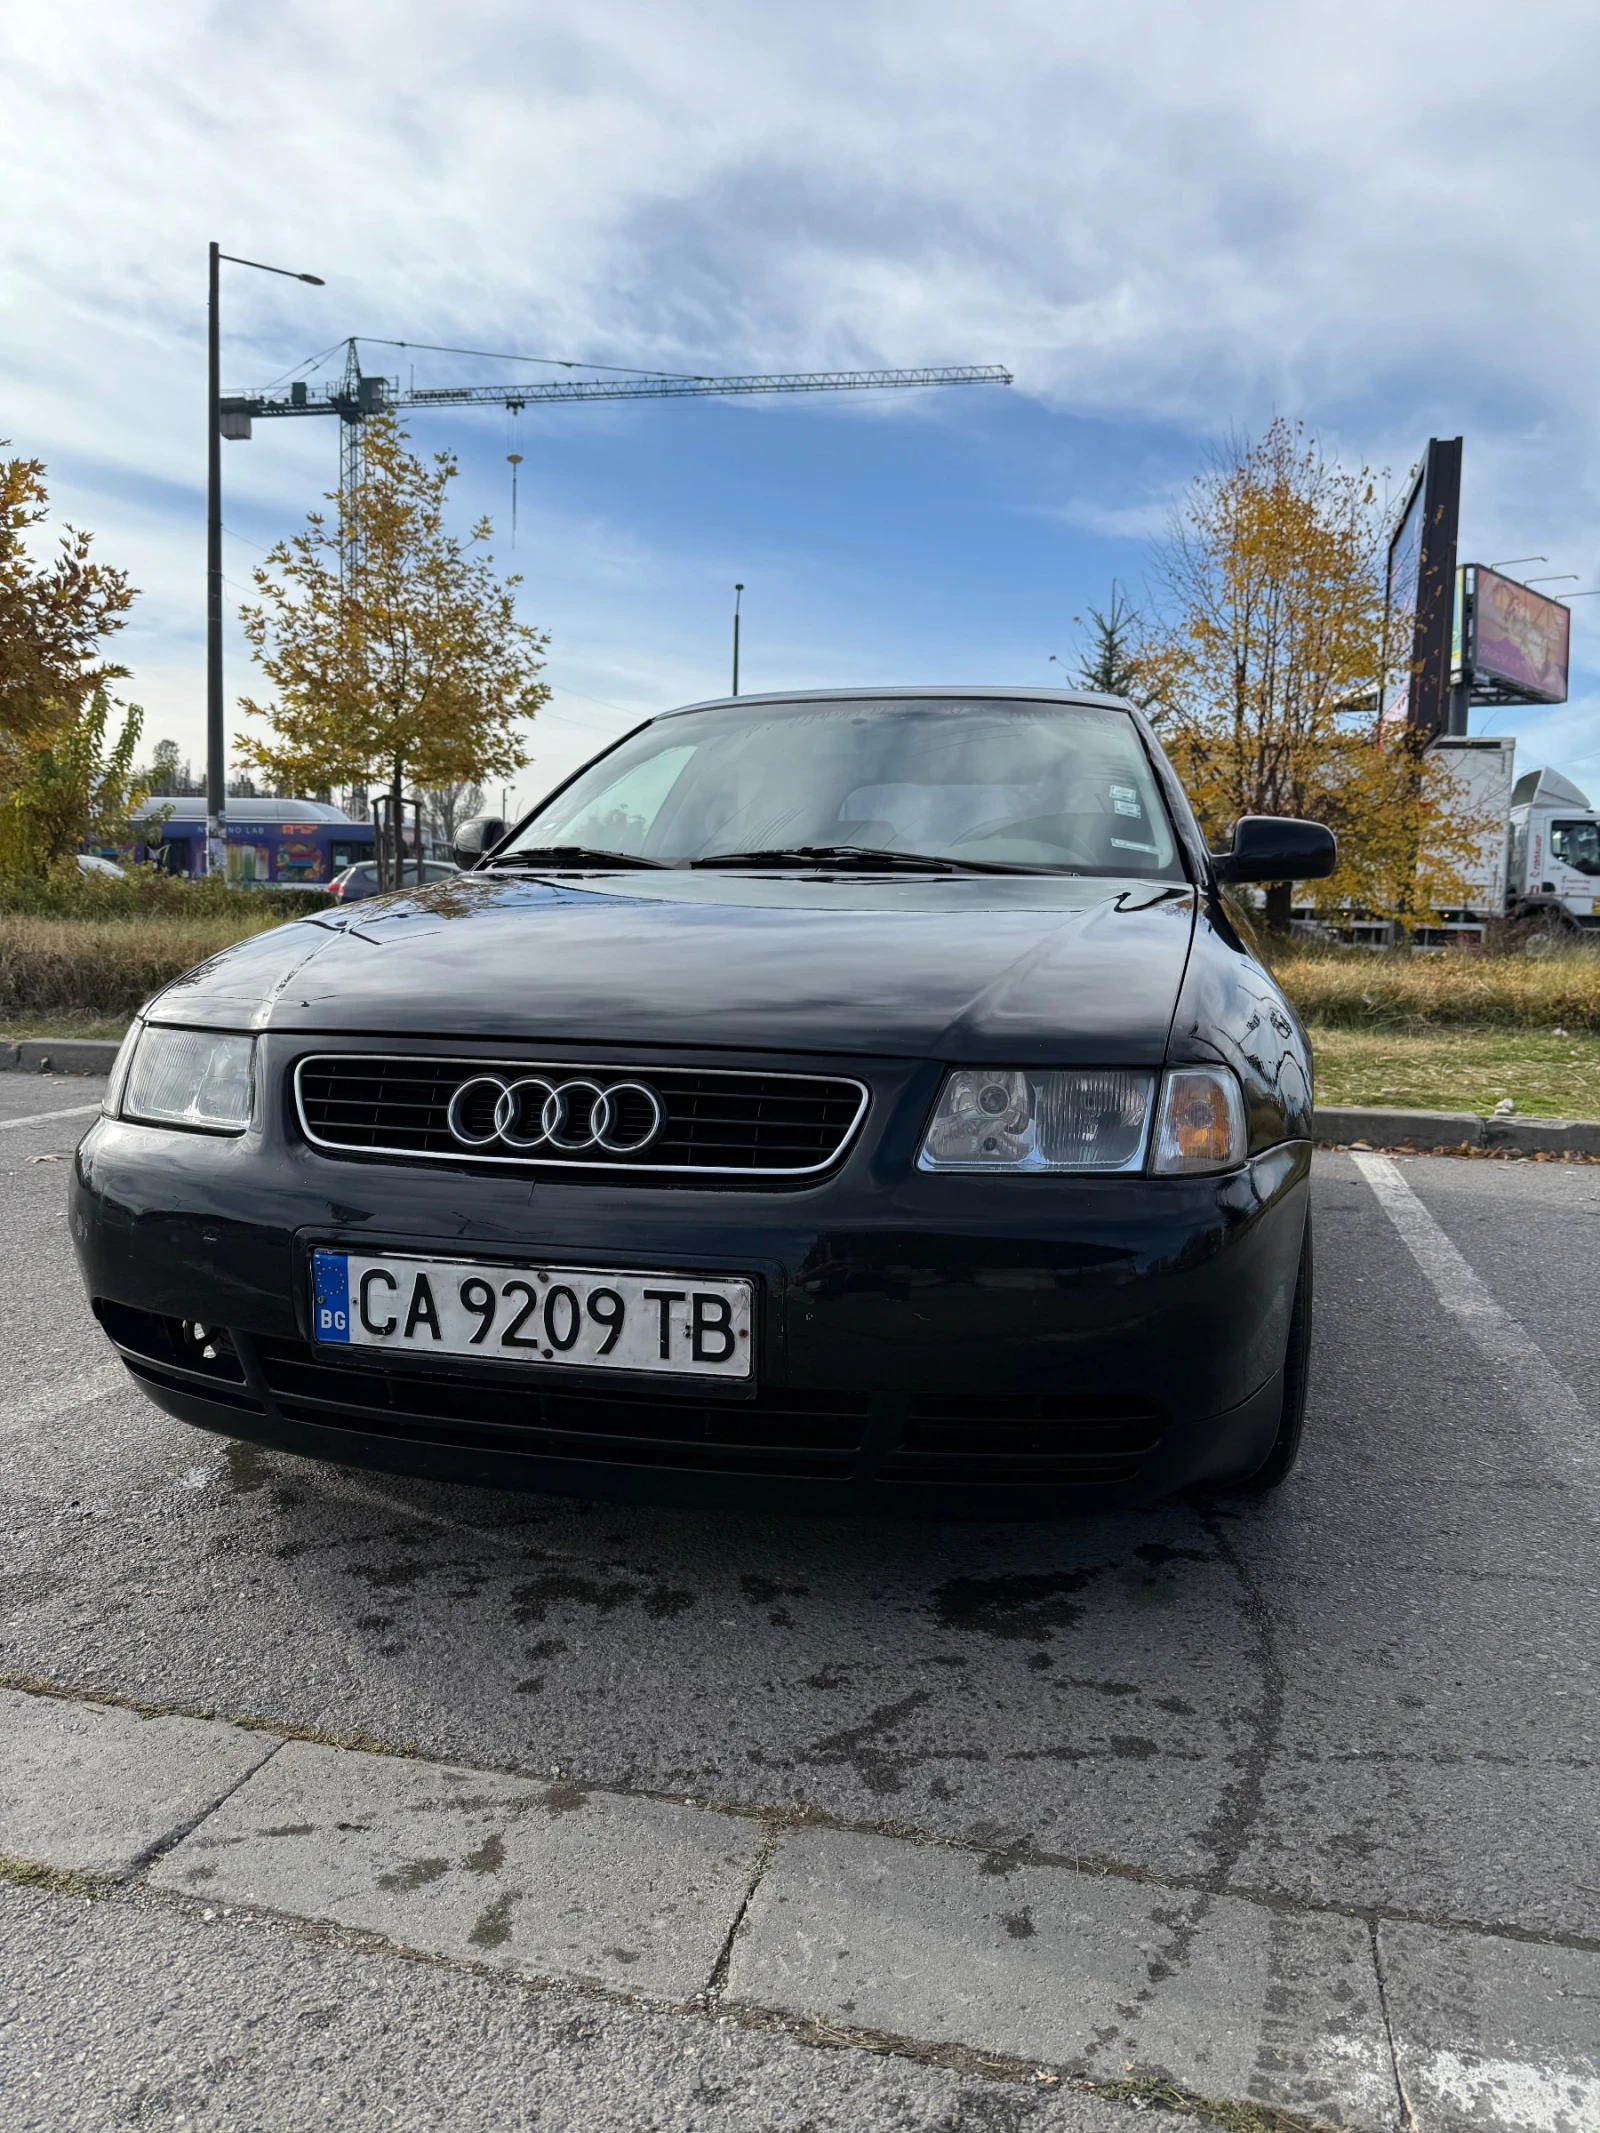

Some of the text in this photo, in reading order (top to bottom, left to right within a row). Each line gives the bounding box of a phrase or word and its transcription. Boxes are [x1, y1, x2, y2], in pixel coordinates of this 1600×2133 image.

[245, 826, 265, 835] LAB
[320, 1309, 346, 1331] BG
[359, 1268, 735, 1362] CA 9209 TB
